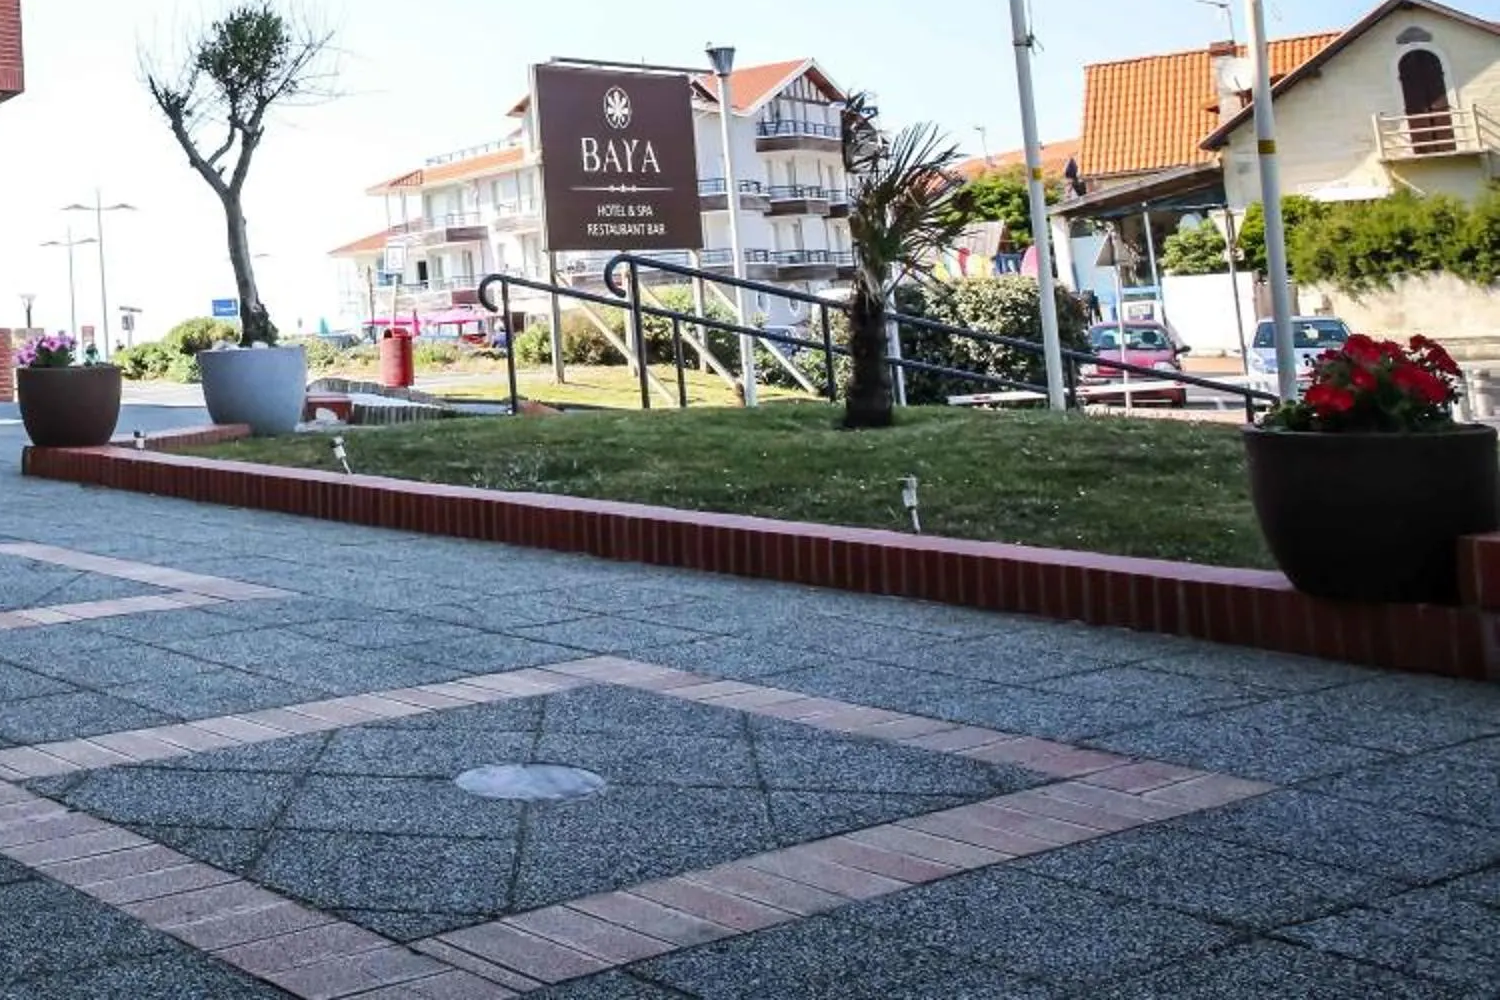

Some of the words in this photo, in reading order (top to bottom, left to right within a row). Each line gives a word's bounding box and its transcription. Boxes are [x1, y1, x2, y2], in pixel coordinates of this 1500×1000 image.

[580, 136, 661, 173] BAYA
[597, 204, 626, 217] HOTEL
[637, 205, 654, 217] SPA
[586, 223, 645, 237] RESTAURANT
[647, 223, 665, 236] BAR
